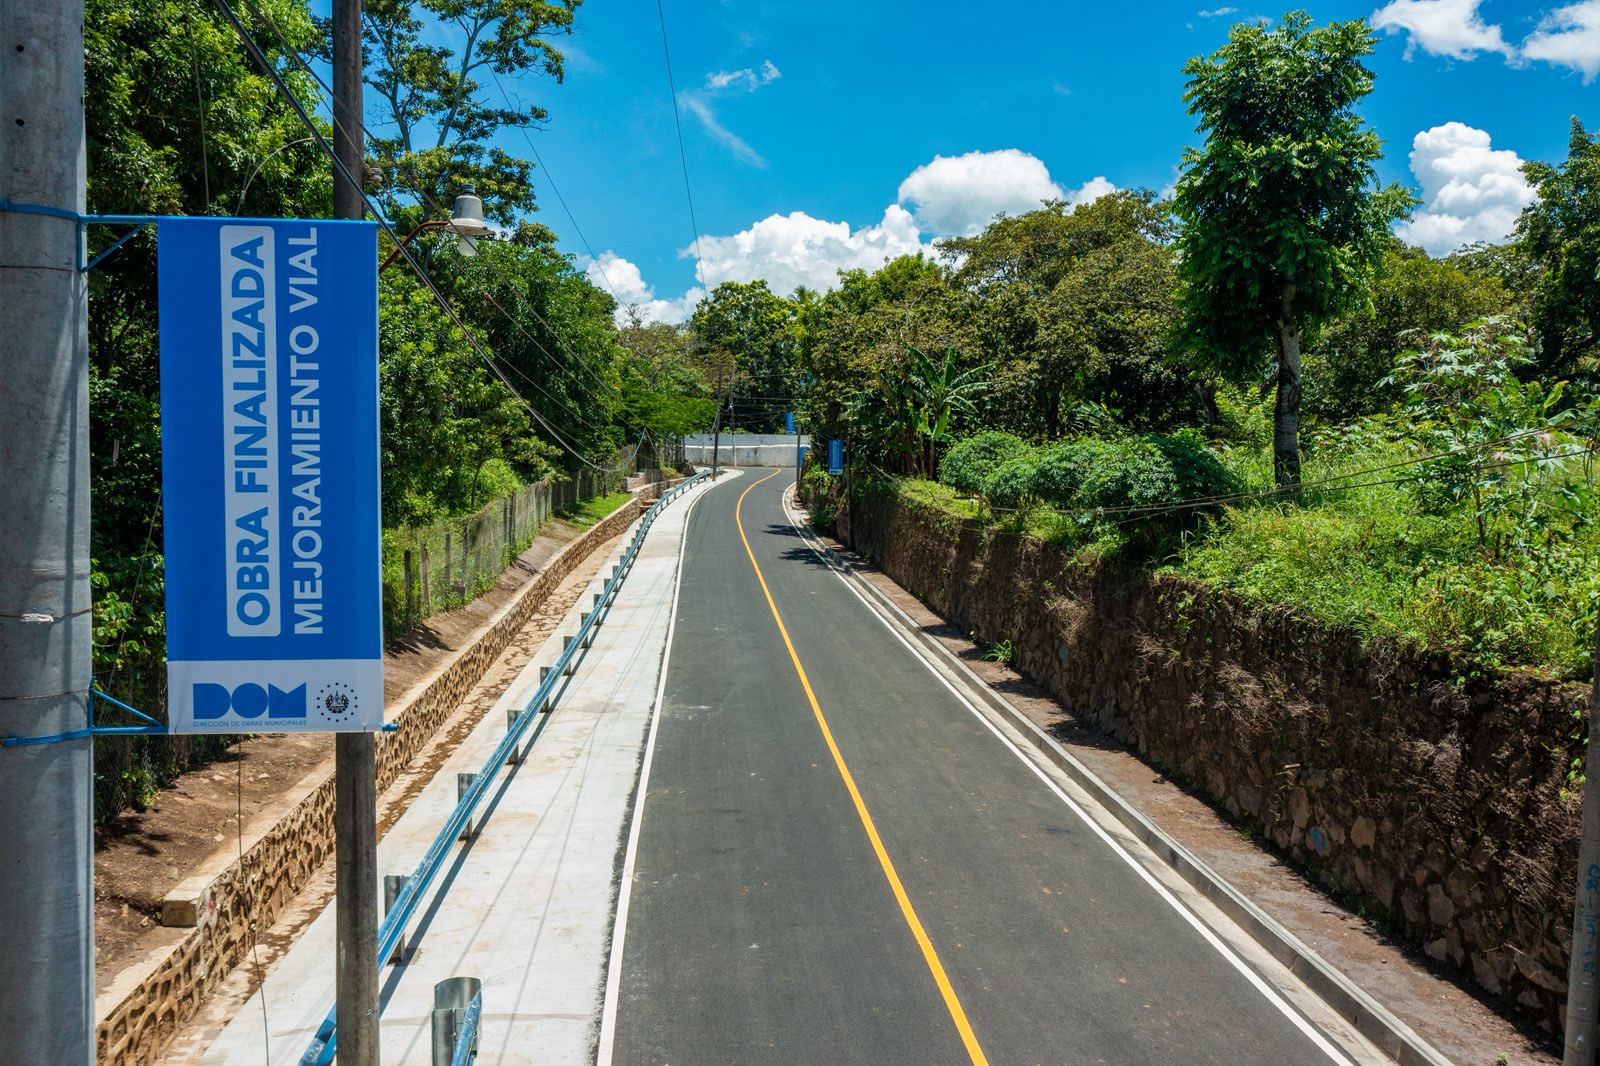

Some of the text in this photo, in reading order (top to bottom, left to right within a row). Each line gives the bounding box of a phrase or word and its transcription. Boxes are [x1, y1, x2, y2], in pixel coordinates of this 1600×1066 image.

[230, 235, 271, 626] OBRA FINALIZADA
[287, 227, 324, 635] MEJORAMIENTO VIAL
[192, 682, 307, 720] DOM
[193, 720, 229, 728] DIRECCIÓN
[264, 719, 307, 727] MUNICIPALES
